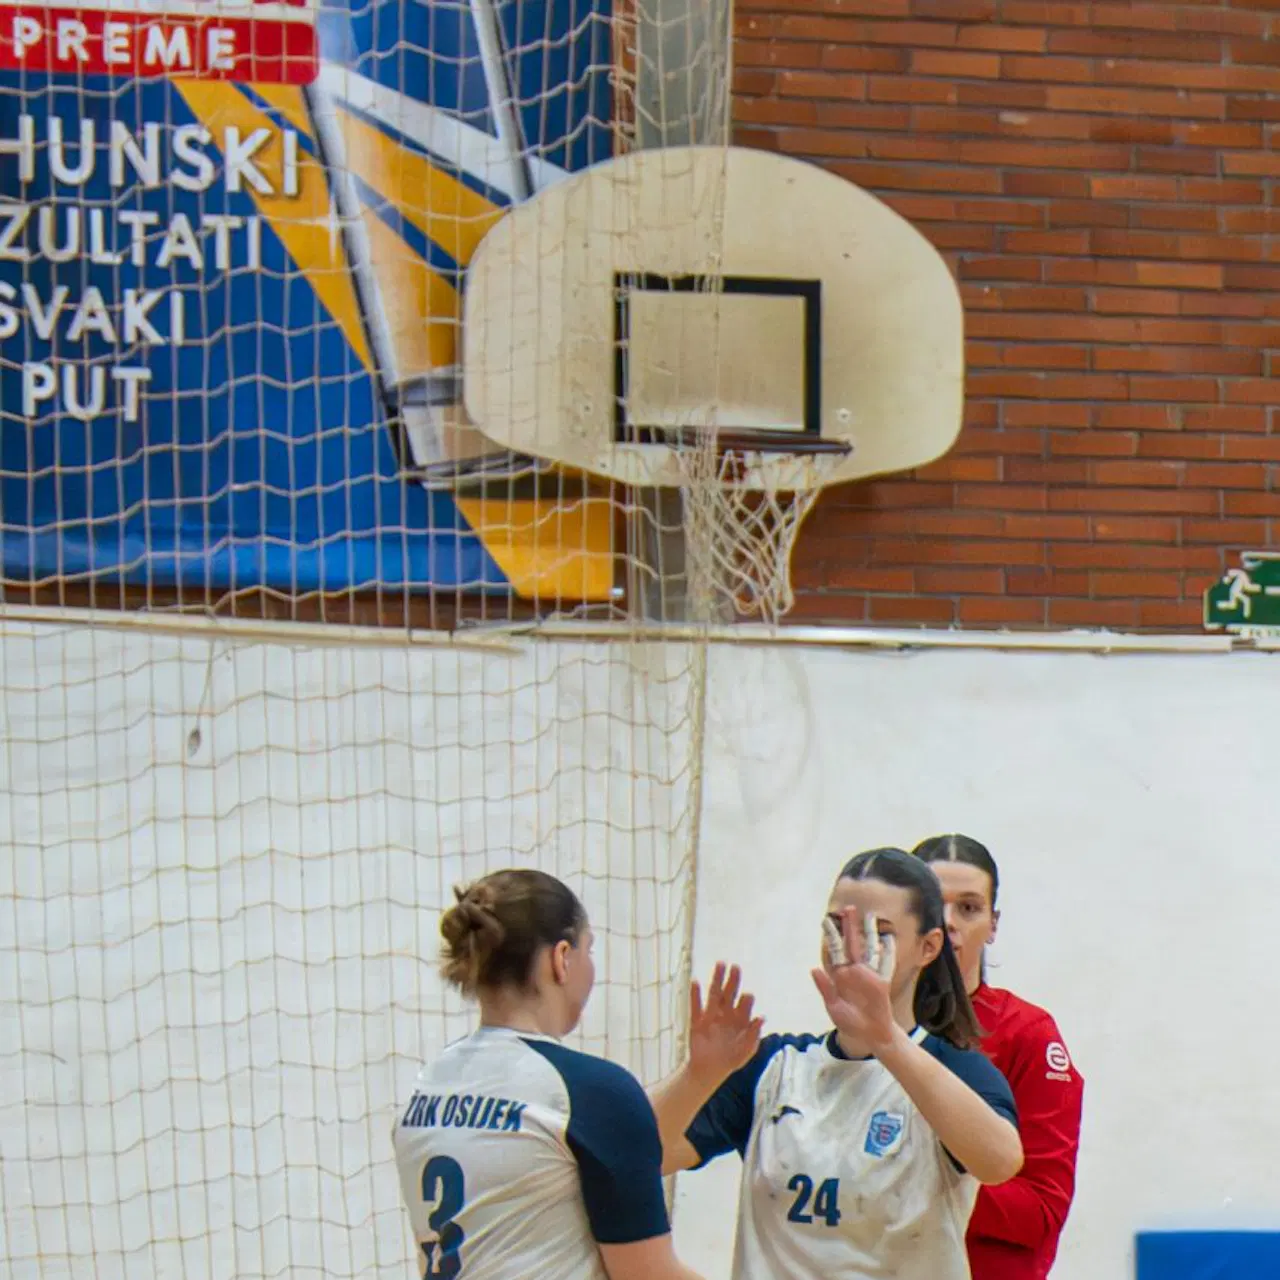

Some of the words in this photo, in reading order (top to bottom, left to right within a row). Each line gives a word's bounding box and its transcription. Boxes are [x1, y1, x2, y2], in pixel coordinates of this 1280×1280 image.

[13, 16, 236, 70] PREME
[0, 114, 299, 197] HUNSKI
[0, 204, 261, 270] ZULTATI
[0, 280, 185, 346] SVAKI
[22, 361, 152, 423] PUT
[441, 1095, 528, 1132] OSIJEK
[787, 1173, 842, 1227] 24
